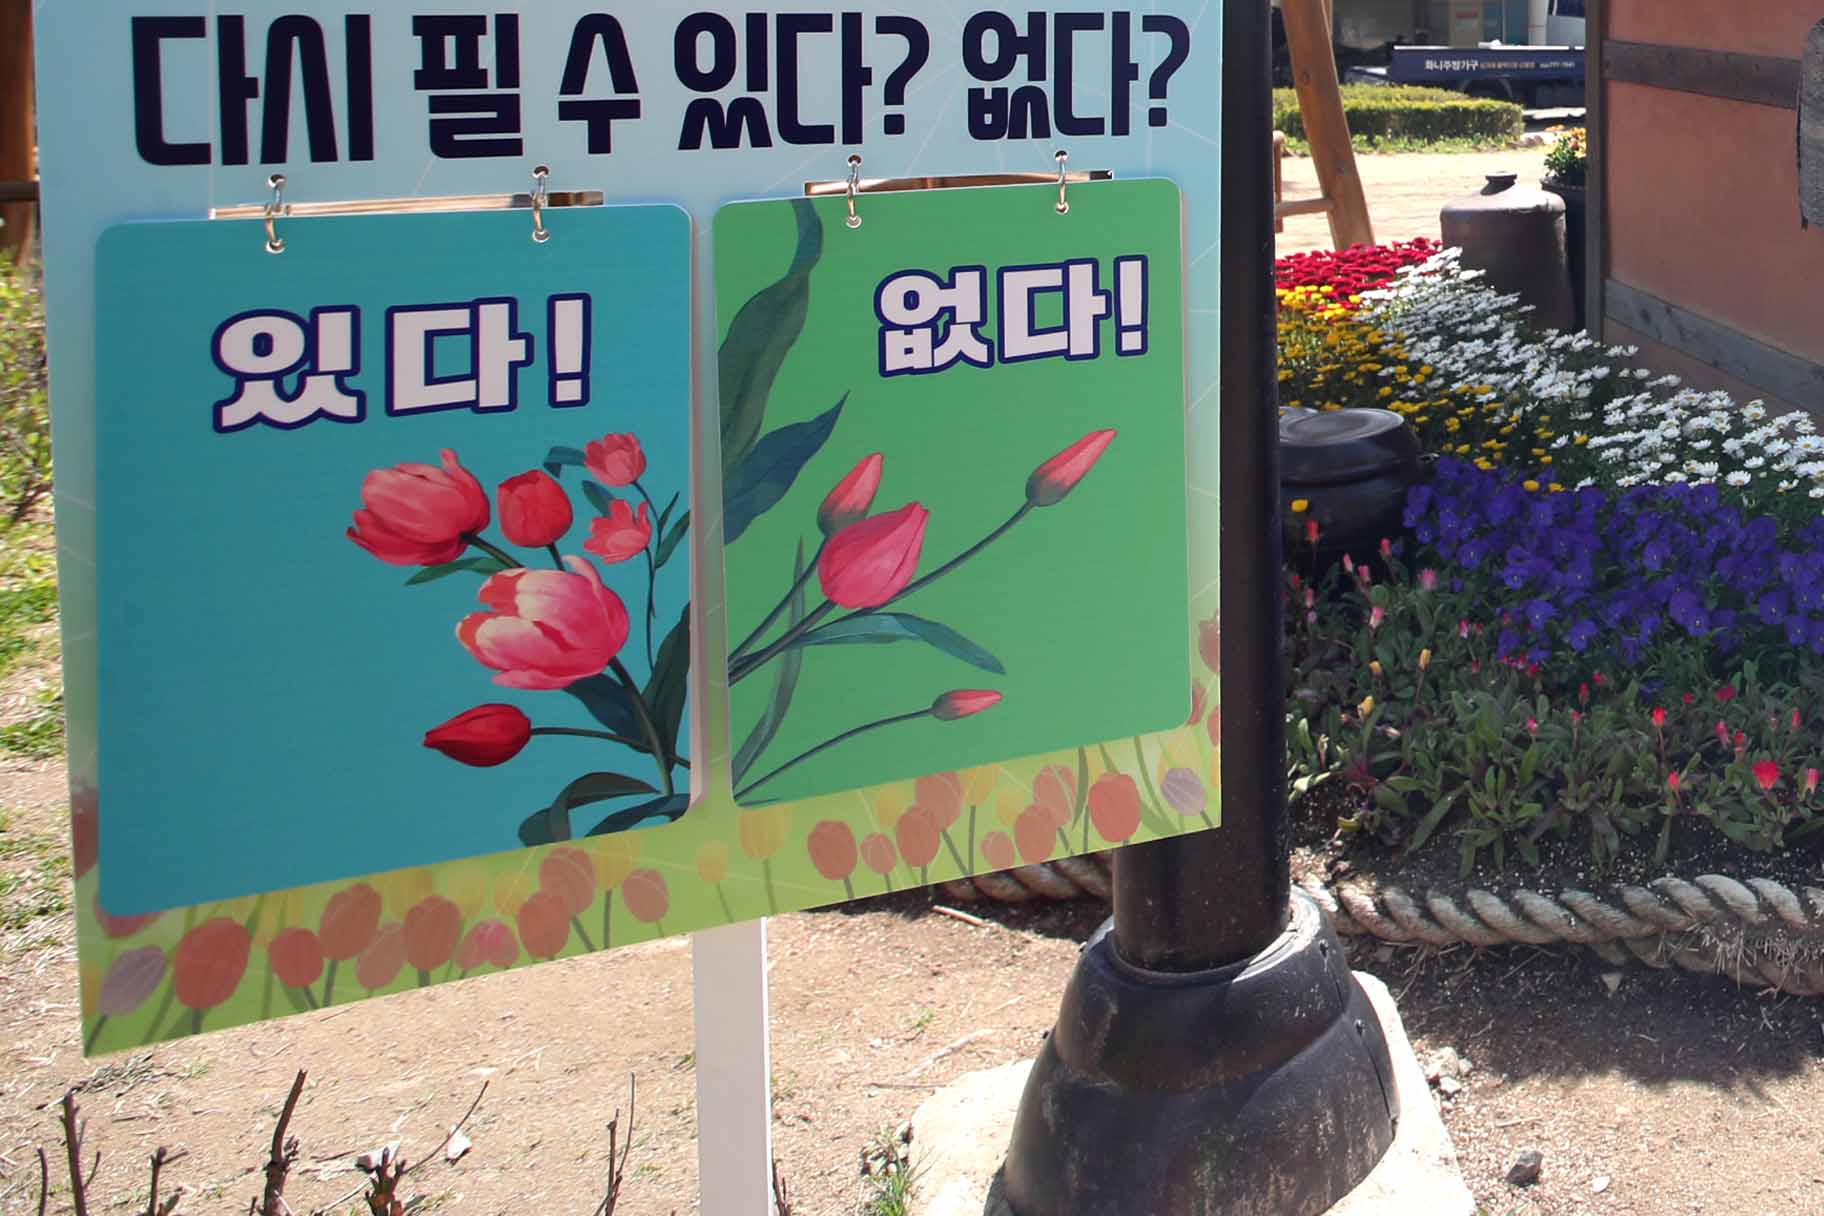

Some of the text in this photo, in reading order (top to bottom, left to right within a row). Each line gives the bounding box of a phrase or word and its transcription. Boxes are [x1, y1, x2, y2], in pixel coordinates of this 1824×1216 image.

[130, 10, 1191, 167] 다시 필 수 있다? 없다?
[211, 292, 592, 434] 있다!
[874, 254, 1149, 378] 없다!
